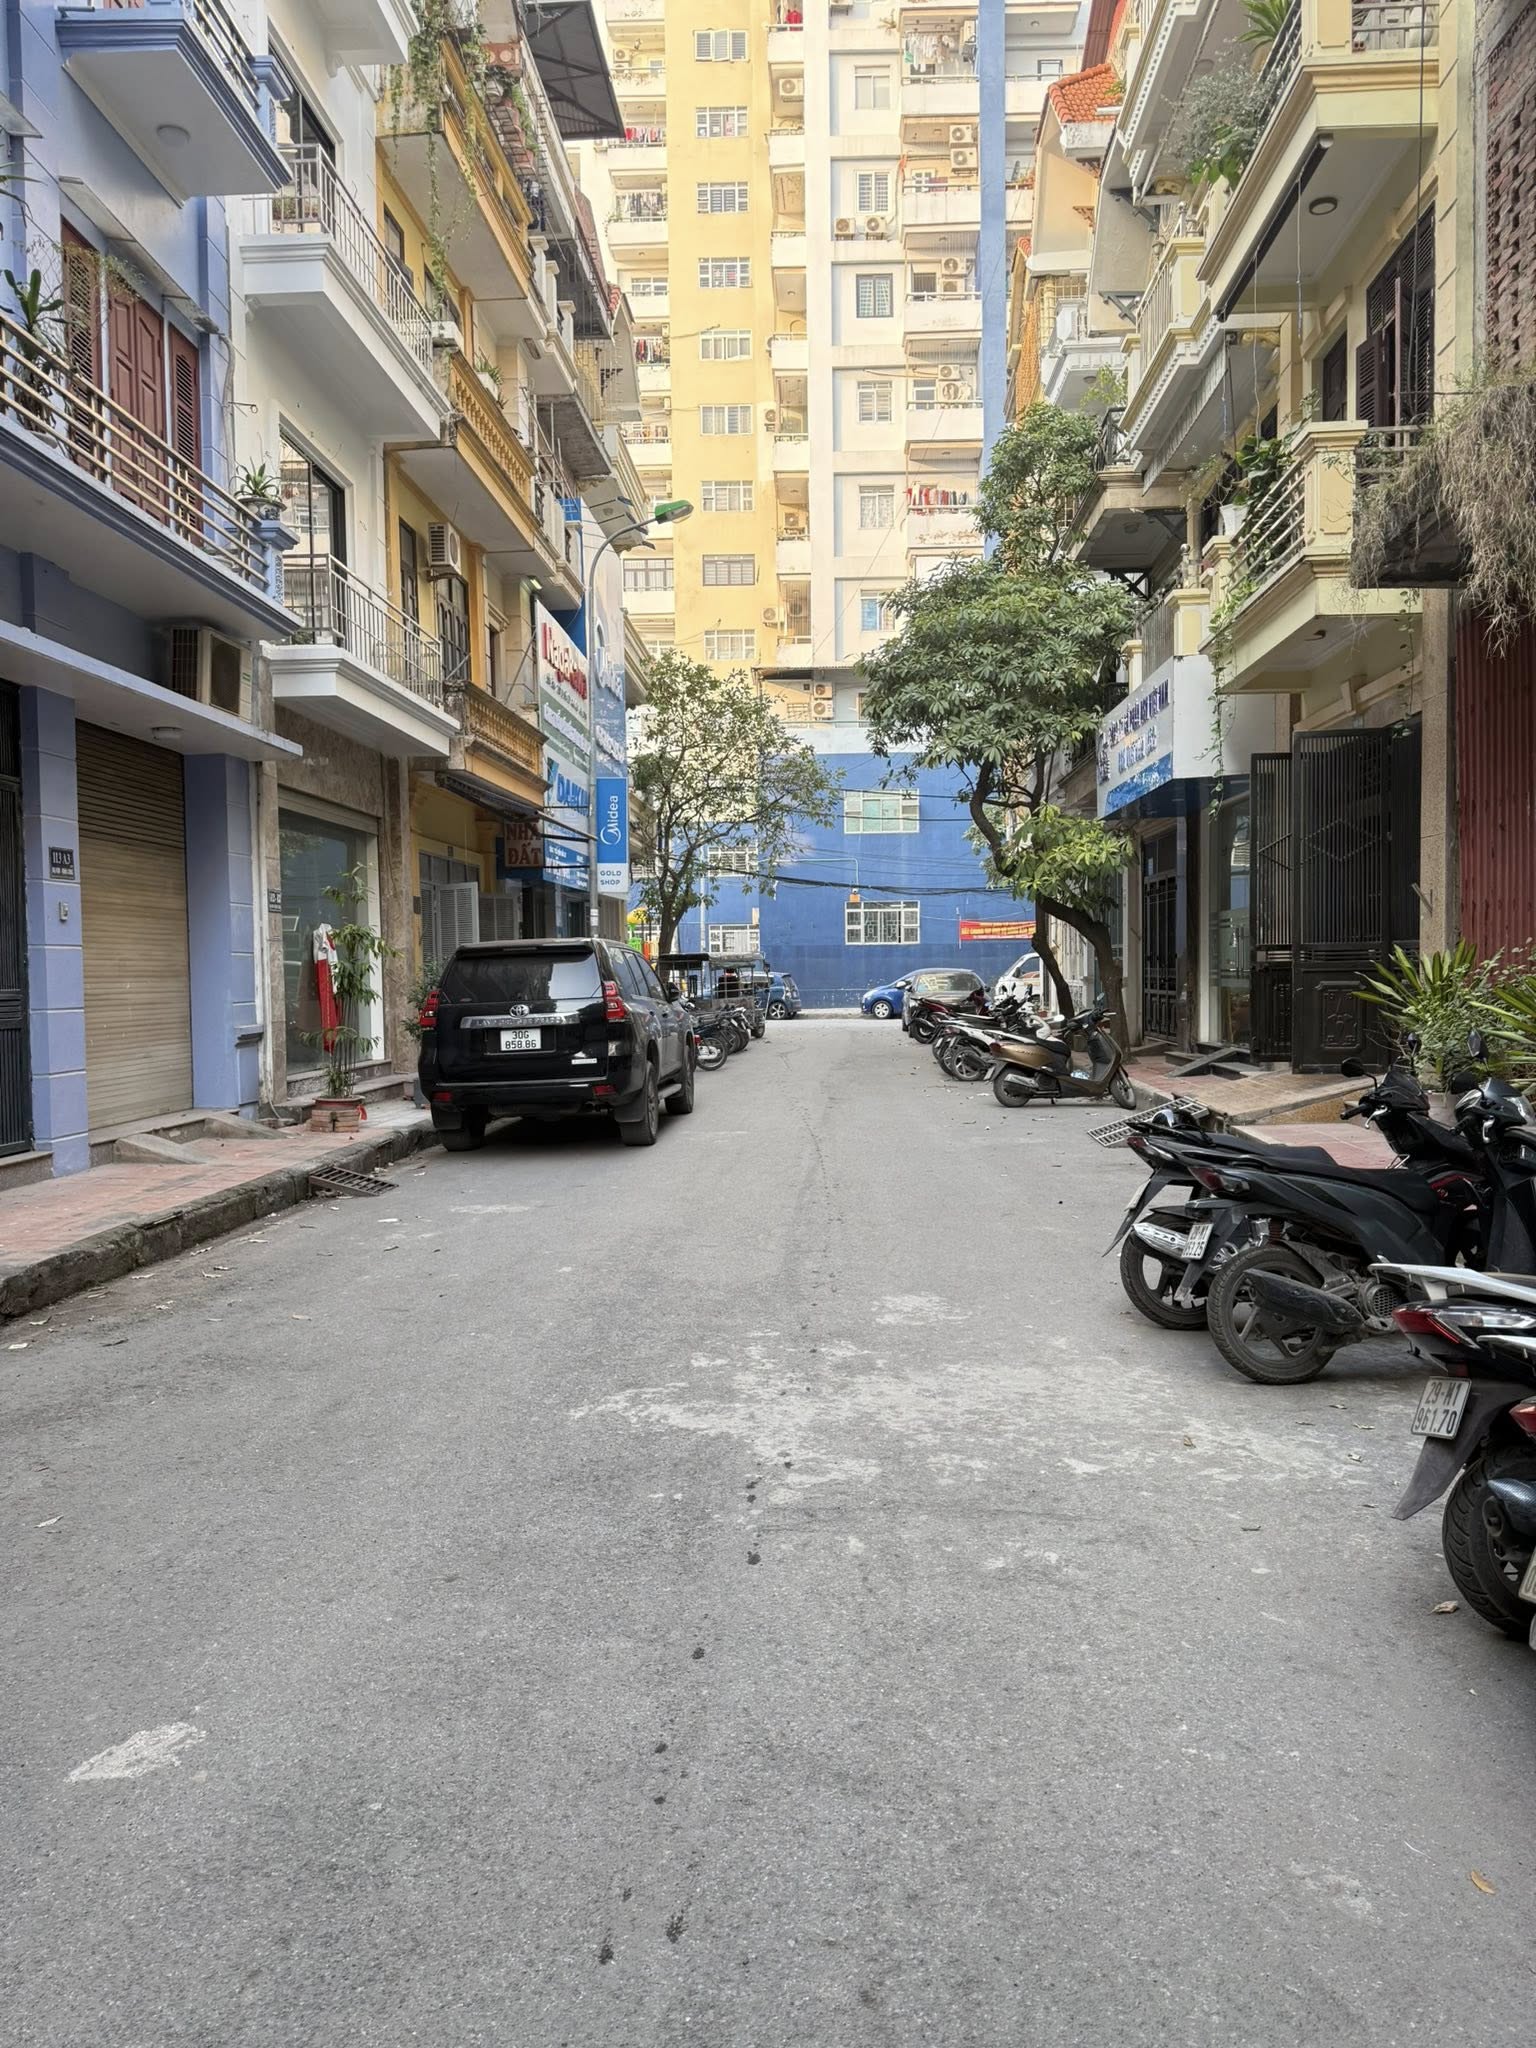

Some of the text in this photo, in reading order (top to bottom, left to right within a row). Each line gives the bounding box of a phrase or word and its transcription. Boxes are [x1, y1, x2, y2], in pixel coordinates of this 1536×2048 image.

[600, 795, 622, 845] Midea
[508, 841, 541, 865] ĐẤT
[505, 1039, 537, 1049] 858.86
[511, 1030, 530, 1040] 30G
[1414, 1407, 1457, 1434] 961.70
